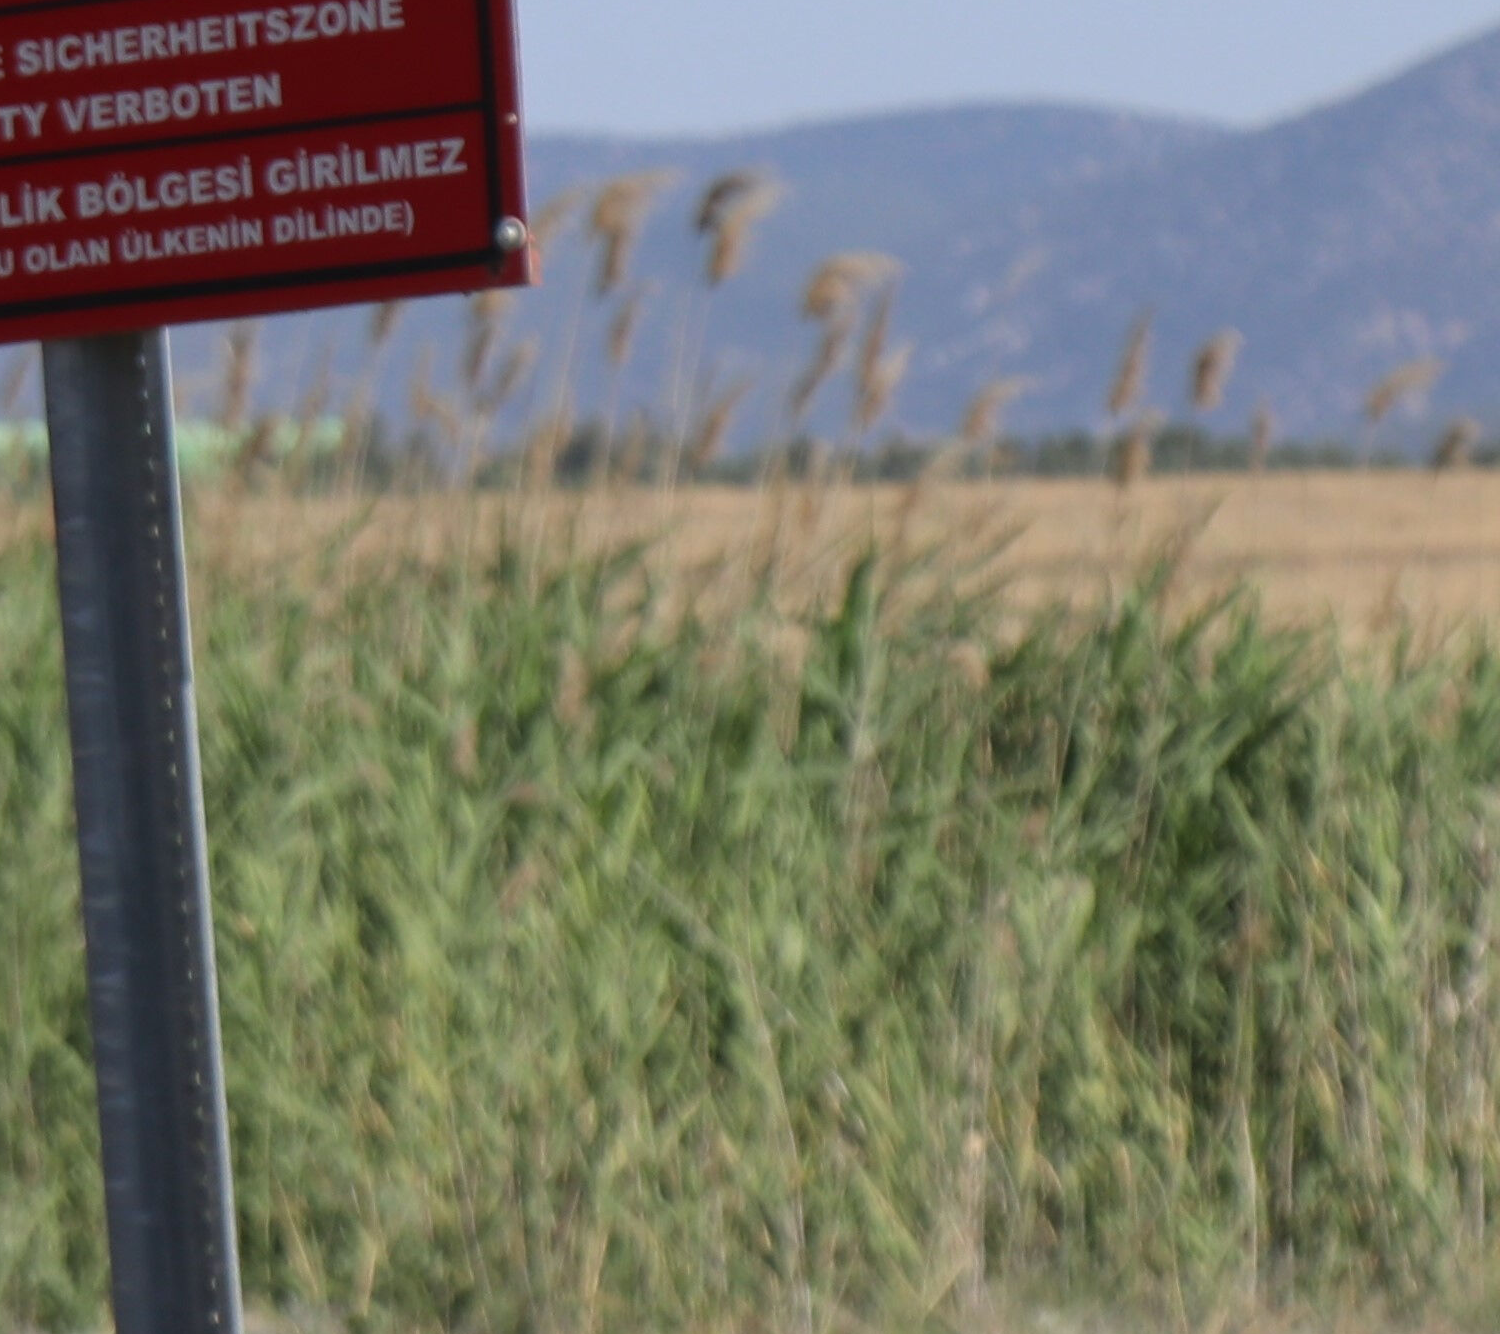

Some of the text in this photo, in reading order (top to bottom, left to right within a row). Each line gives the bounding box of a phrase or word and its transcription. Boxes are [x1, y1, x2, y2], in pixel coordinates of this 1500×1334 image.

[60, 74, 282, 132] VERBOTEN
[77, 156, 253, 218] BÖLGESİ
[266, 138, 467, 195] GİRİLMEZ
[24, 239, 110, 273] OLAN
[121, 218, 263, 262] ÜLKENİN
[273, 201, 414, 244] DİLİNDE)
